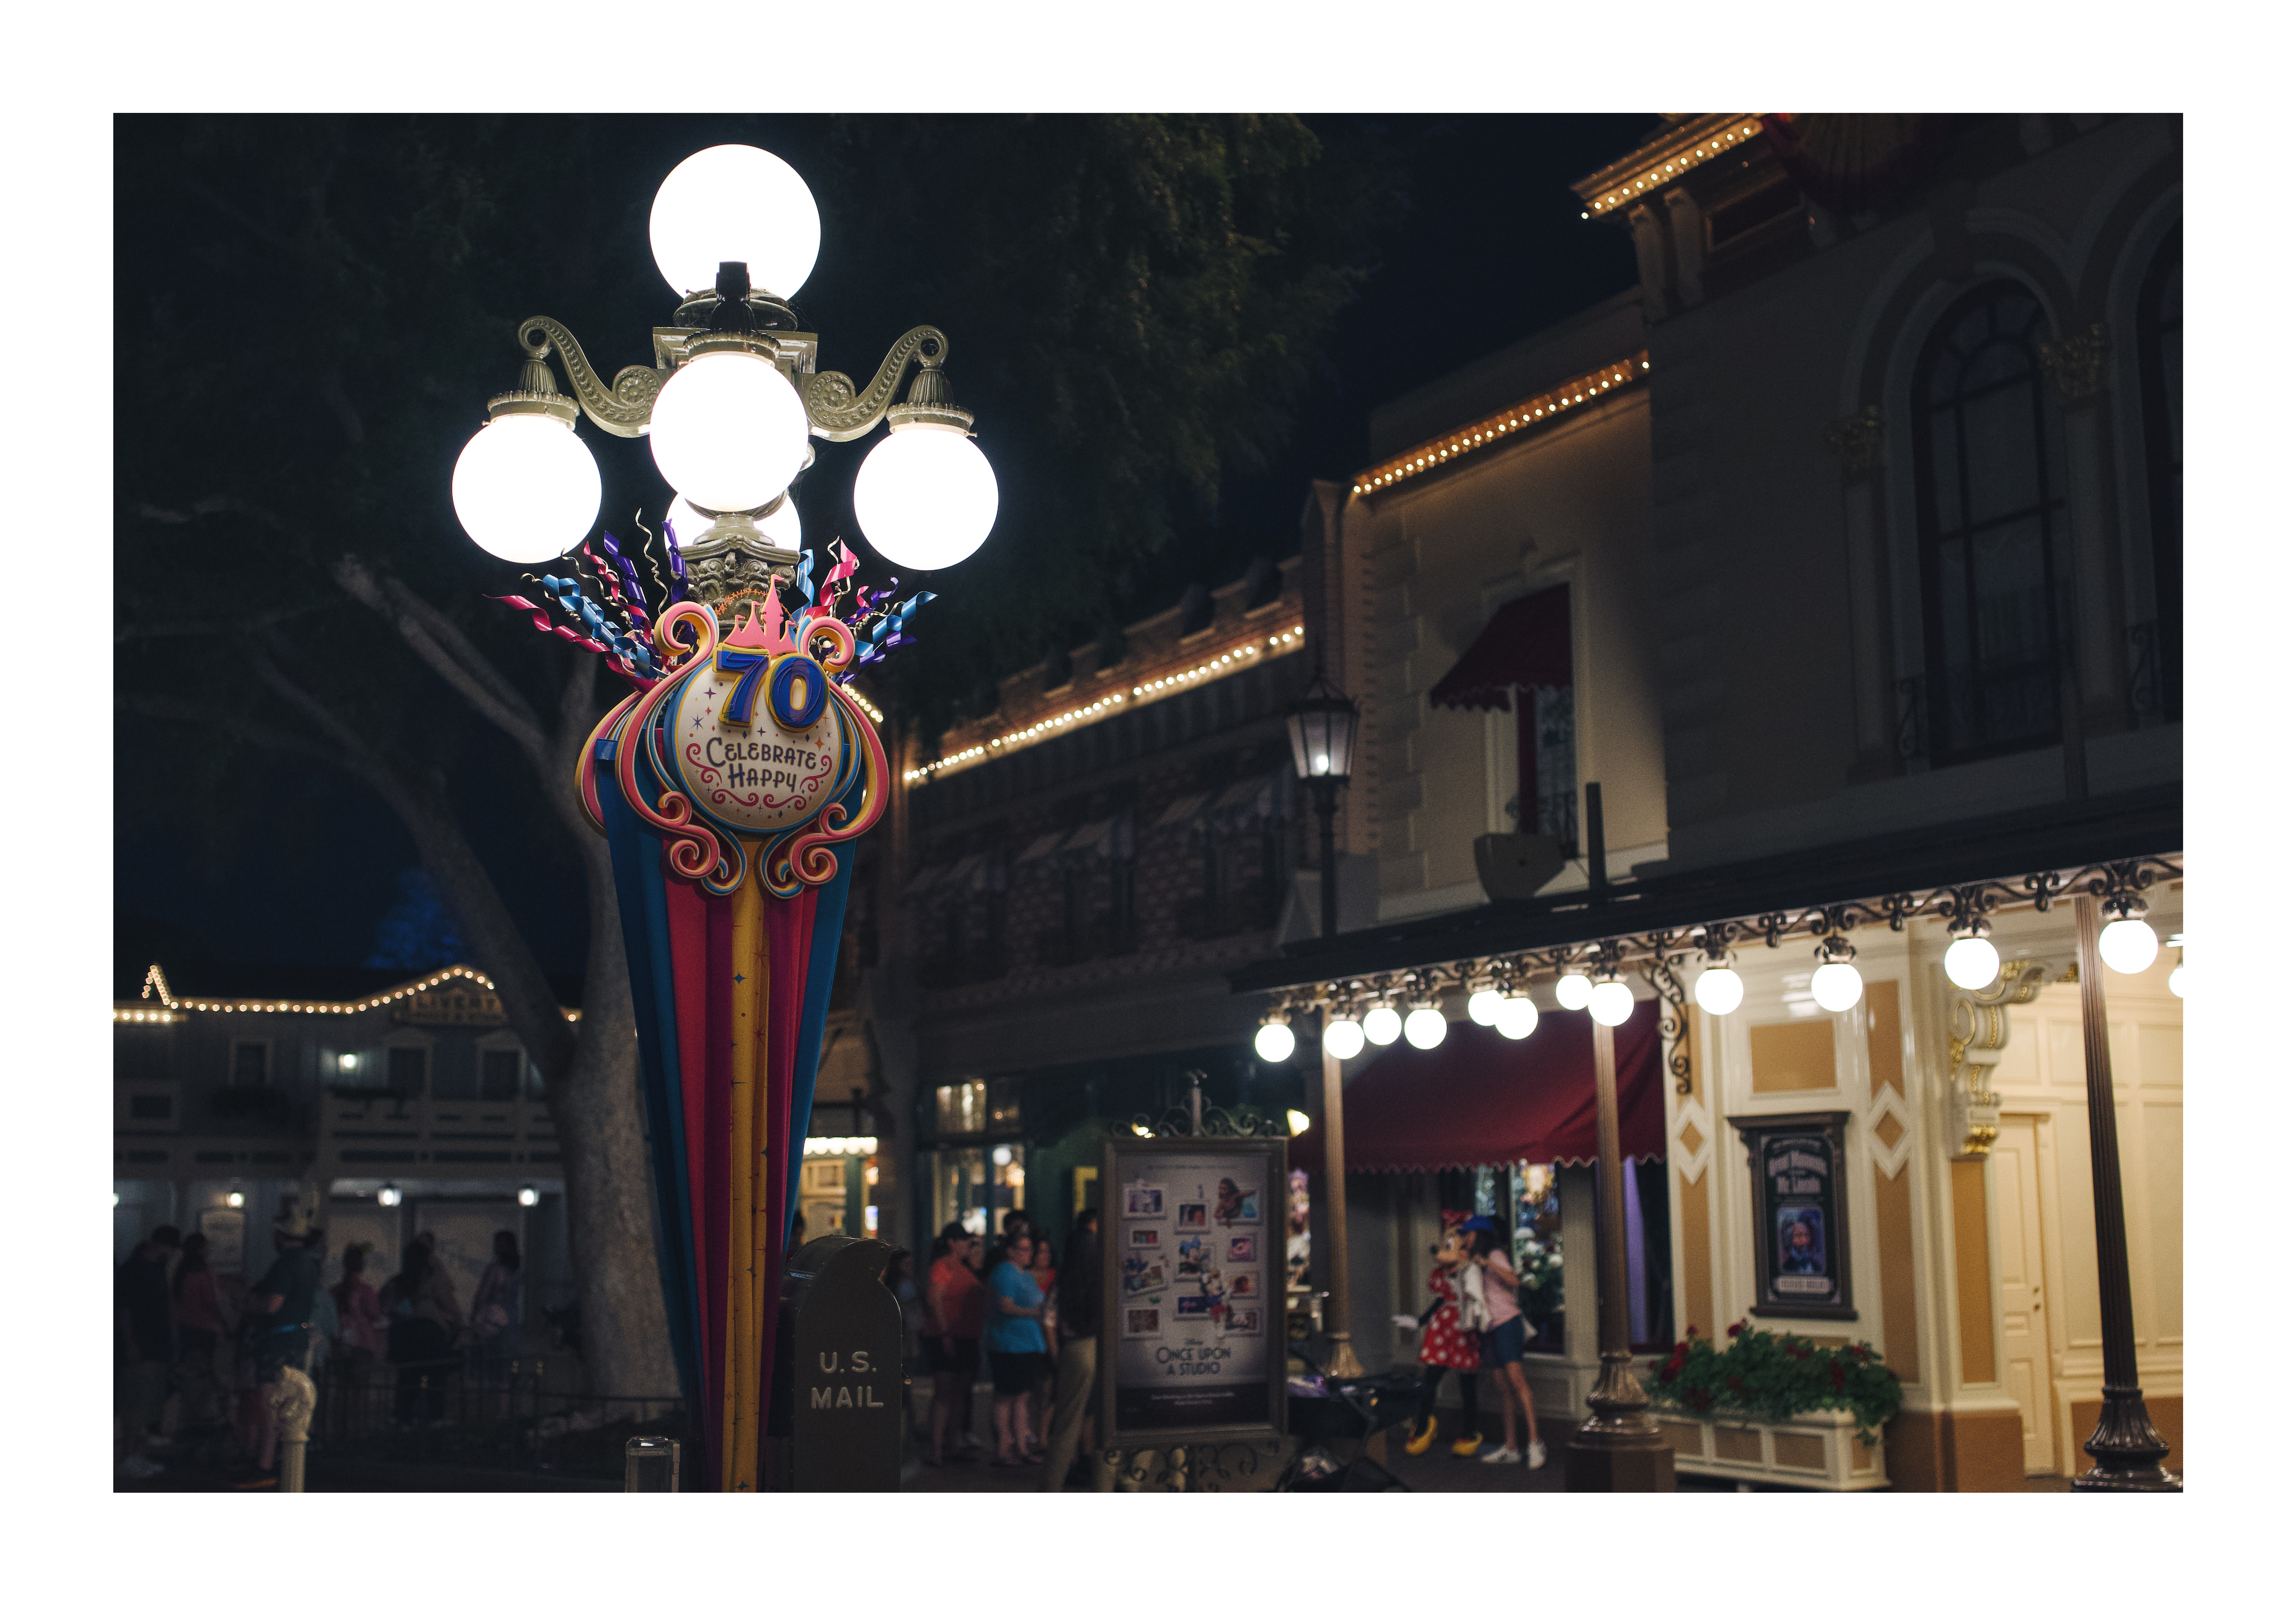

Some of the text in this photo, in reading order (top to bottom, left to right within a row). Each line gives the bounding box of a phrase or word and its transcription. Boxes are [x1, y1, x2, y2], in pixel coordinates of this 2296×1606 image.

[712, 642, 829, 732] 70
[707, 737, 816, 770] CELEBRATE
[728, 763, 797, 793] HAPPY
[820, 1351, 877, 1373] U.S.
[1156, 1347, 1231, 1363] ONCE UPON
[1167, 1362, 1221, 1376] A STUDIO
[811, 1386, 884, 1409] MAIL
